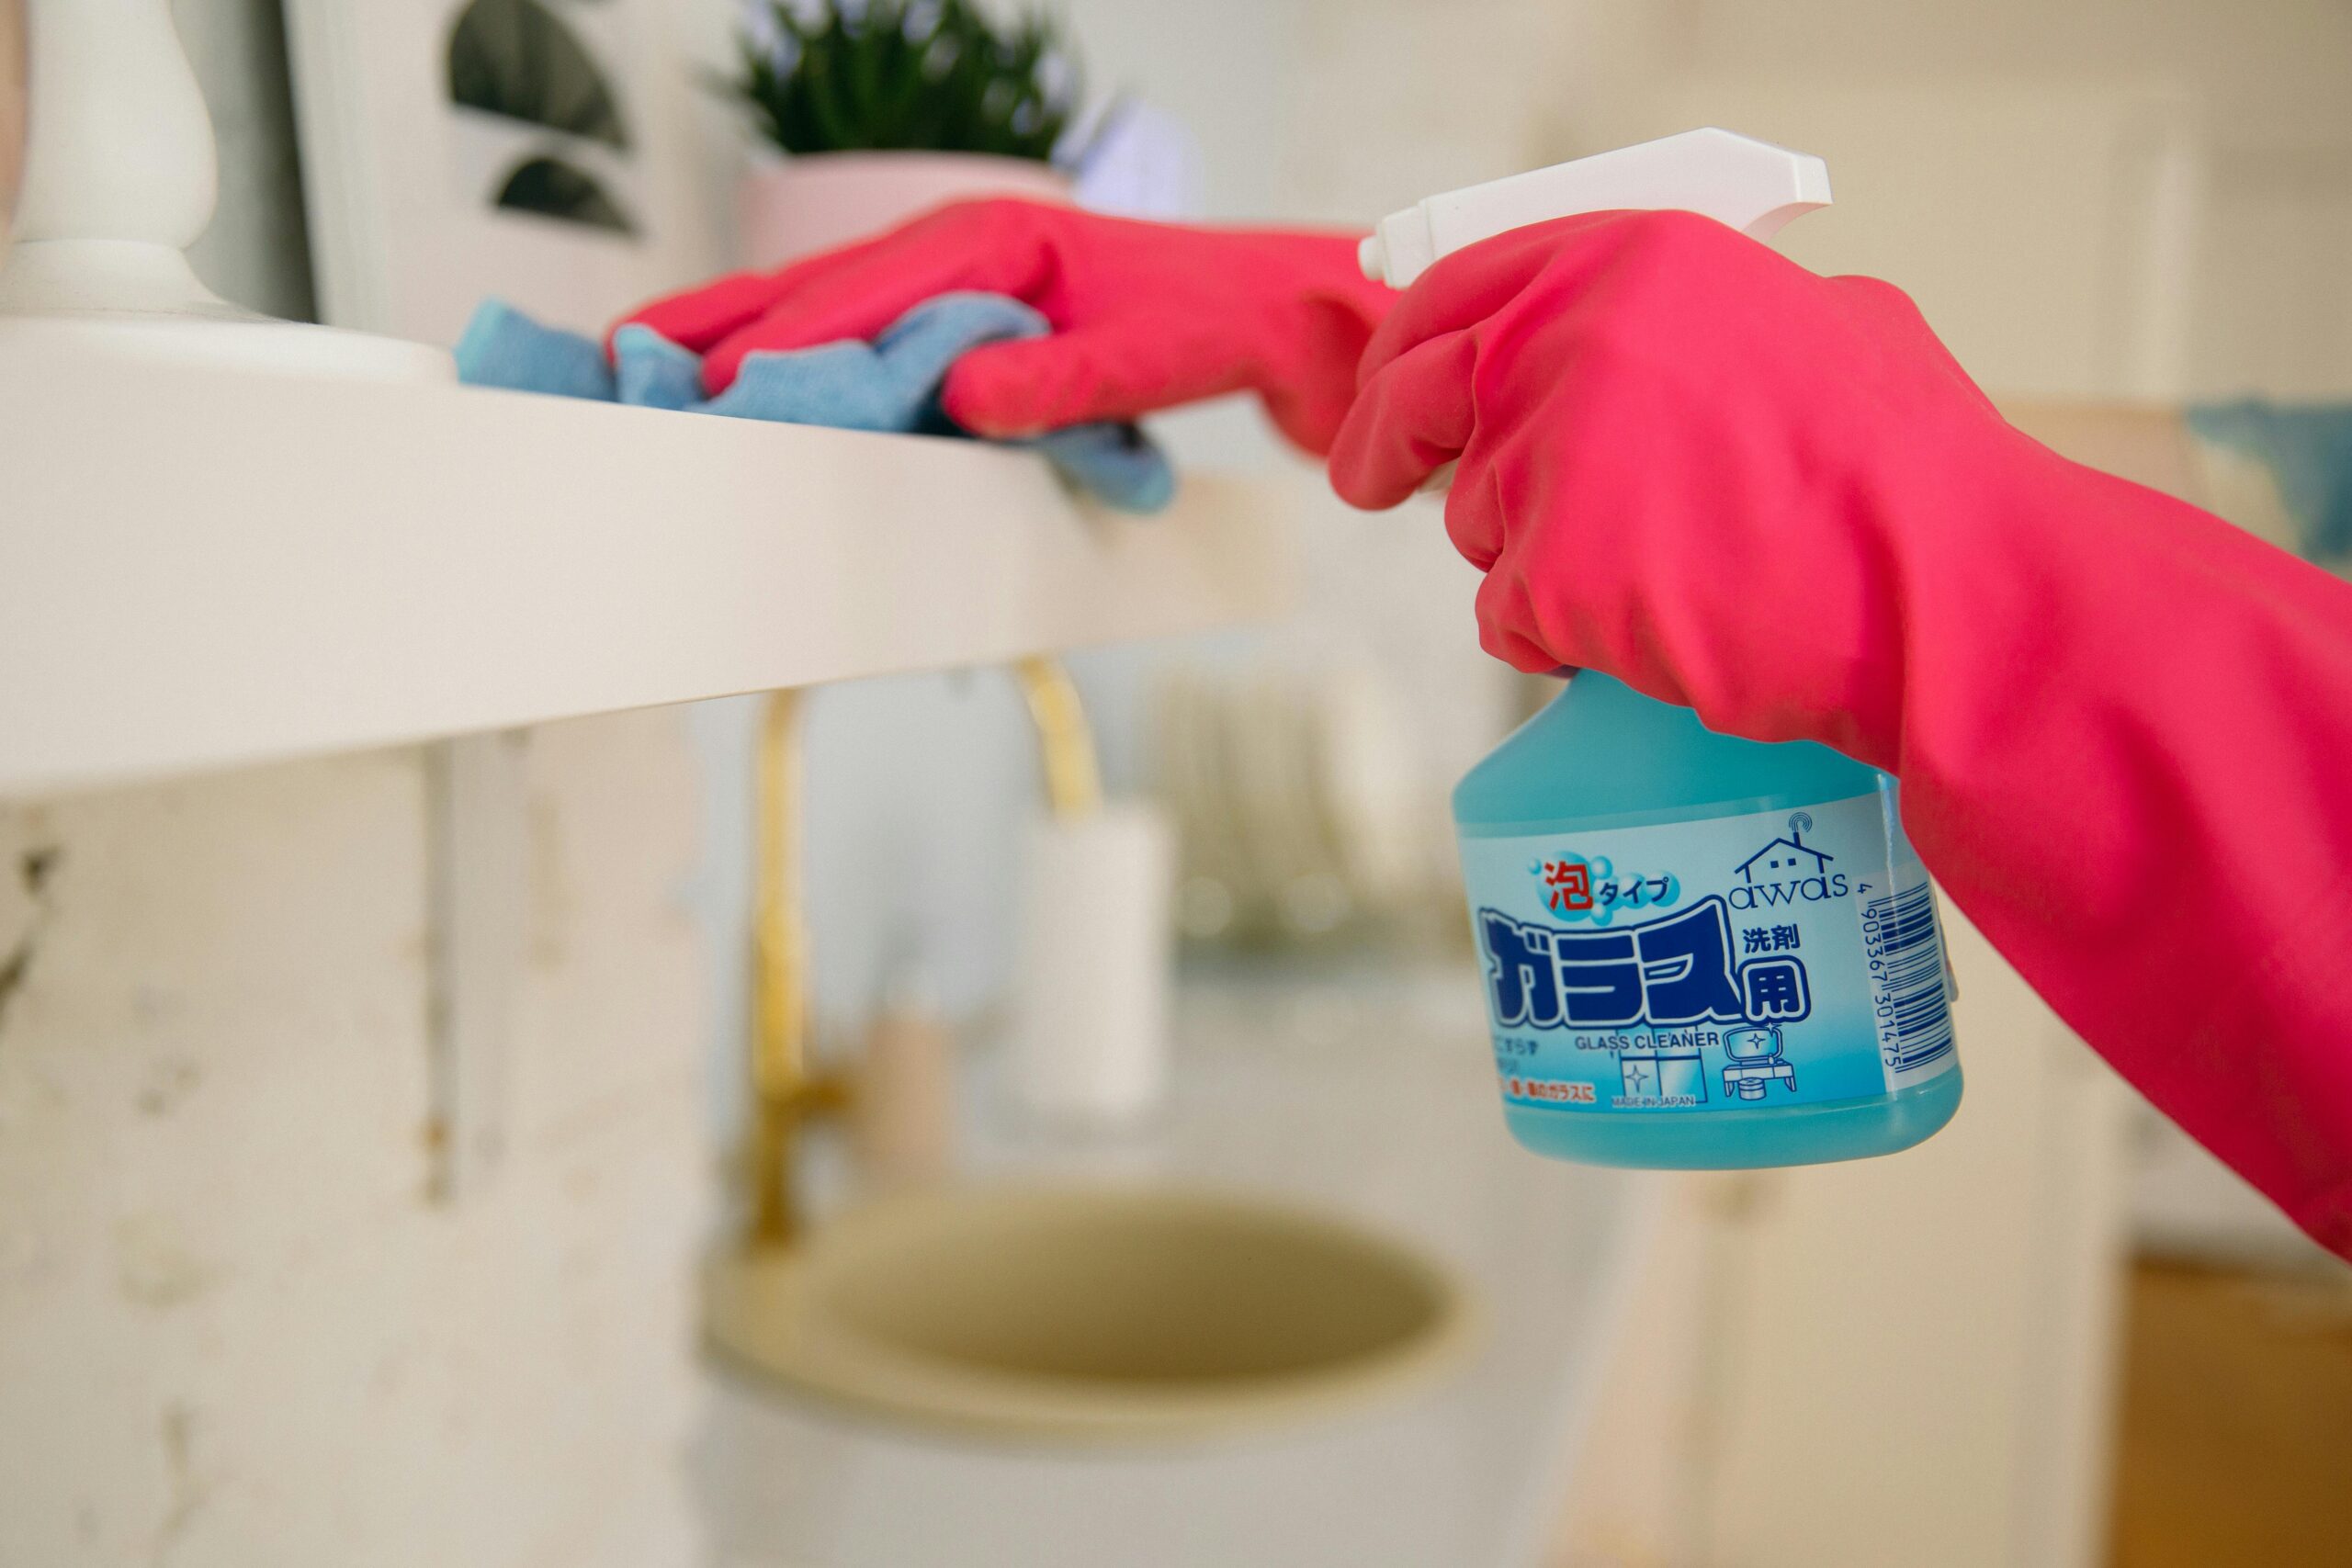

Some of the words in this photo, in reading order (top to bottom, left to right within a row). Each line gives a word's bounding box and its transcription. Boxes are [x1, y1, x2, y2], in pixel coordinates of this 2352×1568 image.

[1728, 873, 1849, 910] awas
[1857, 883, 1873, 895] 4
[1742, 923, 1801, 954] 洗剤
[1860, 908, 1889, 982] 903367
[1574, 1035, 1630, 1050] GLASS
[1634, 1032, 1720, 1049] CLEANER
[1874, 991, 1903, 1068] 301475
[1658, 1095, 1696, 1107] JAPAN
